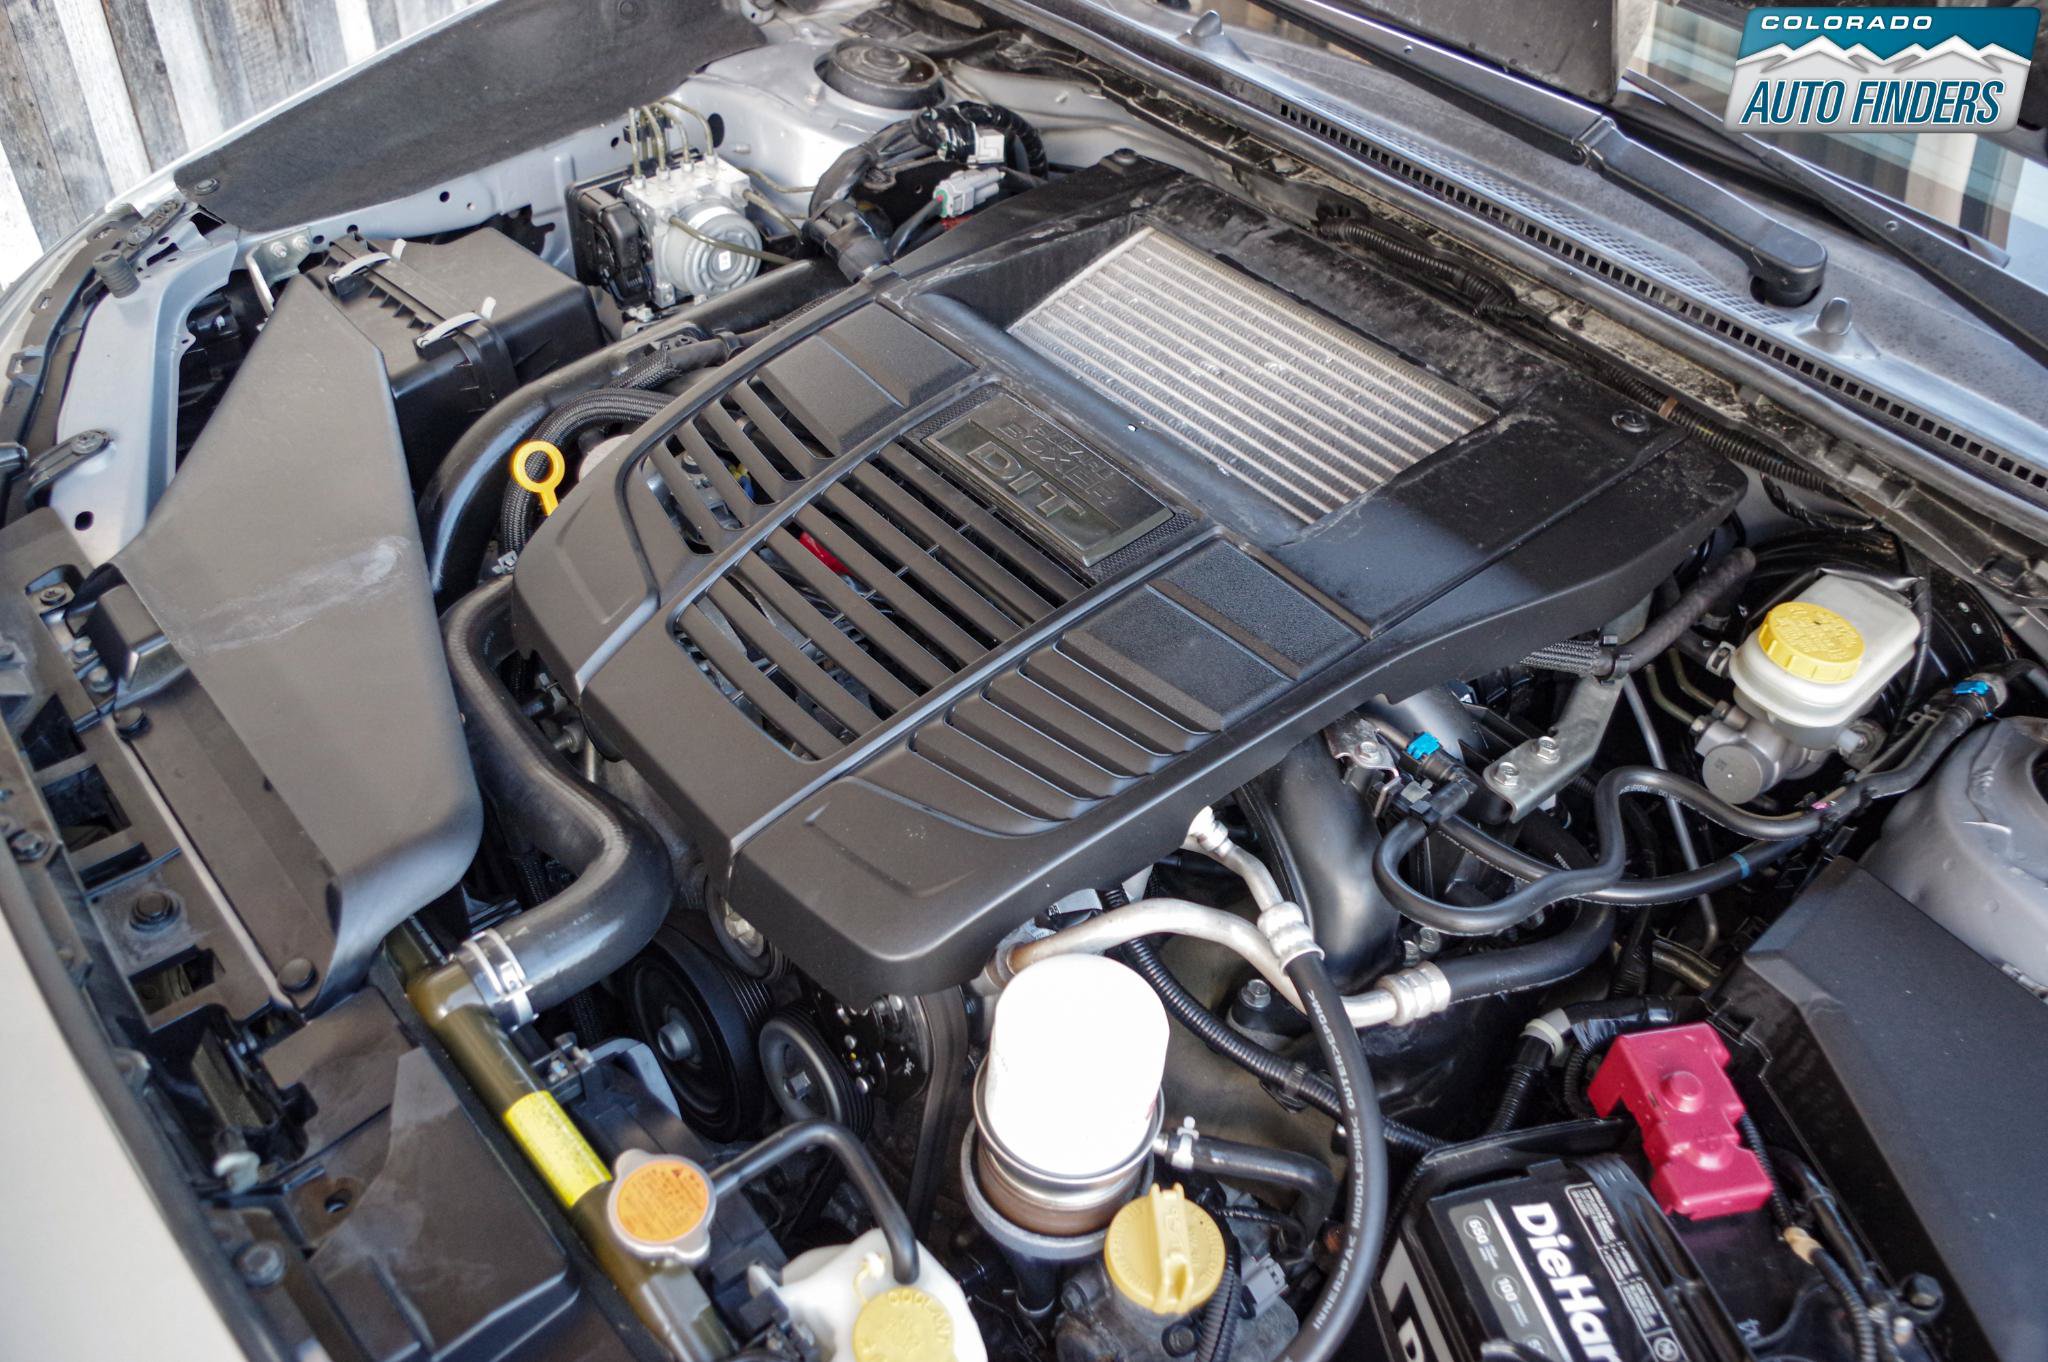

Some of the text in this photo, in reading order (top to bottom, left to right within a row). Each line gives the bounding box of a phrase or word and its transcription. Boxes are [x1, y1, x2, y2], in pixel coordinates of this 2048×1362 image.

[966, 440, 1086, 518] DIT
[997, 422, 1115, 505] BOXER
[1467, 1217, 1490, 1246] 650
[888, 1288, 951, 1343] COOLANT
[1496, 1276, 1517, 1304] 100
